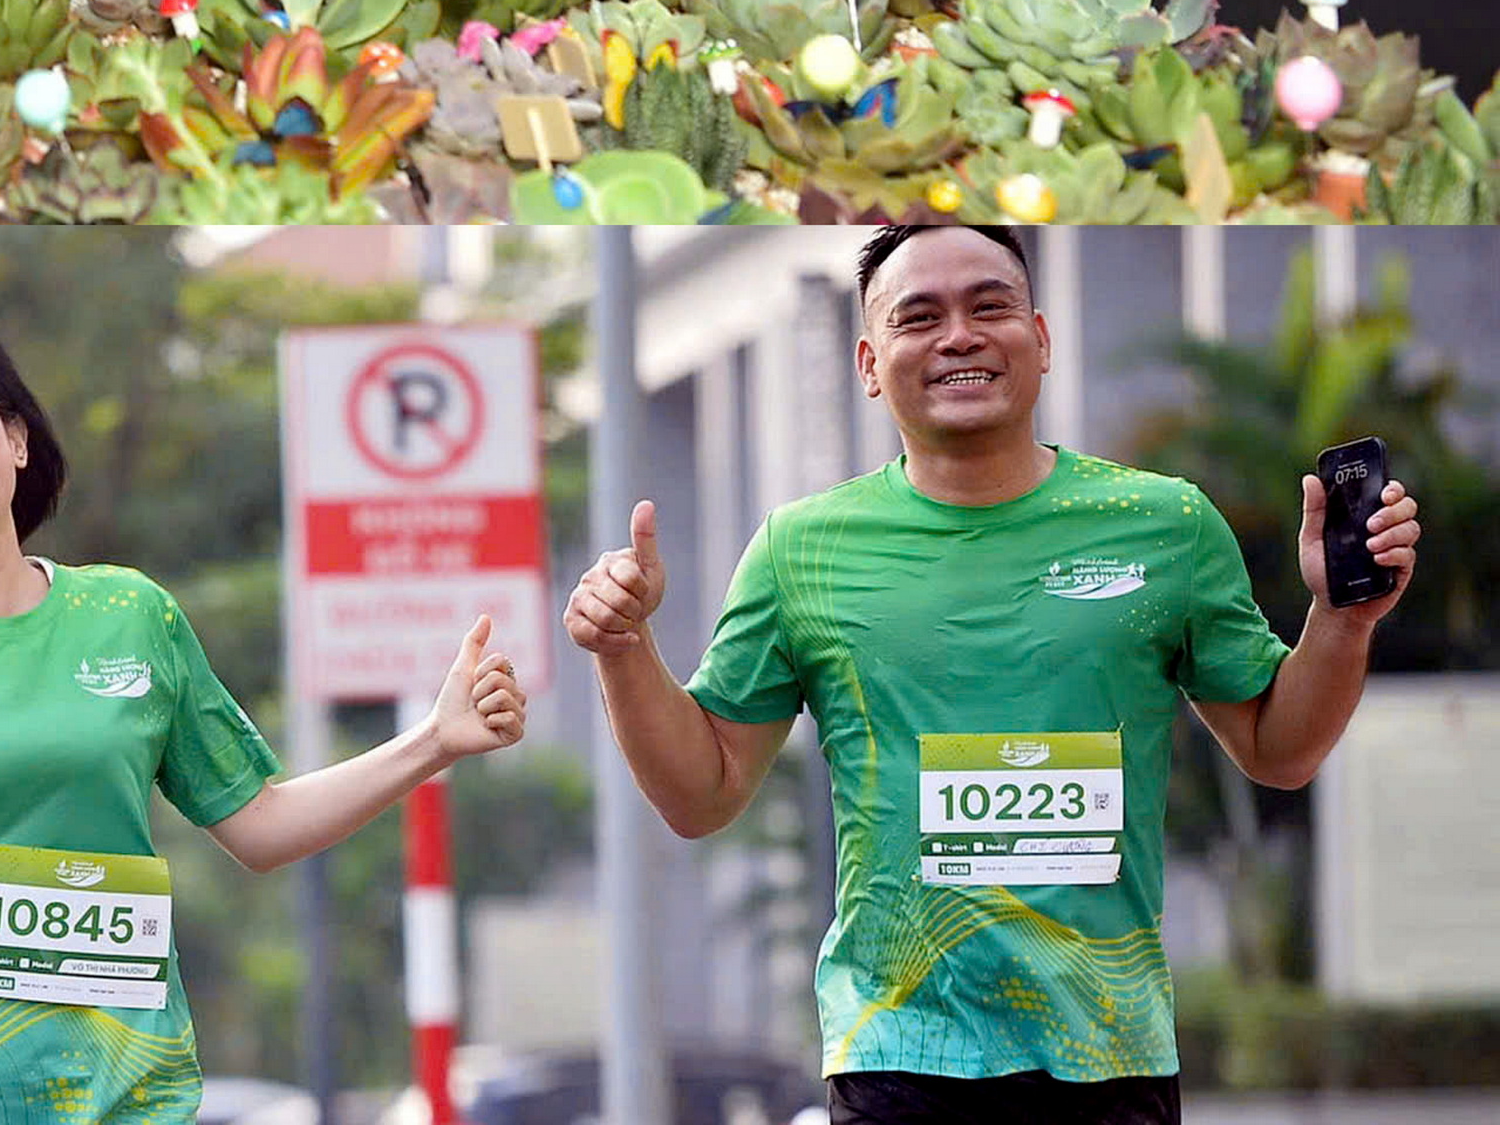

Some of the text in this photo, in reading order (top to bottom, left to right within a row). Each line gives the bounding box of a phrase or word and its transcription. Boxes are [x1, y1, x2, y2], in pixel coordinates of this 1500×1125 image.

[1335, 464, 1369, 485] 07:15
[1072, 574, 1116, 586] XANH
[938, 782, 1086, 821] 10223
[942, 843, 968, 852] T-shirt
[940, 863, 970, 874] 10KM
